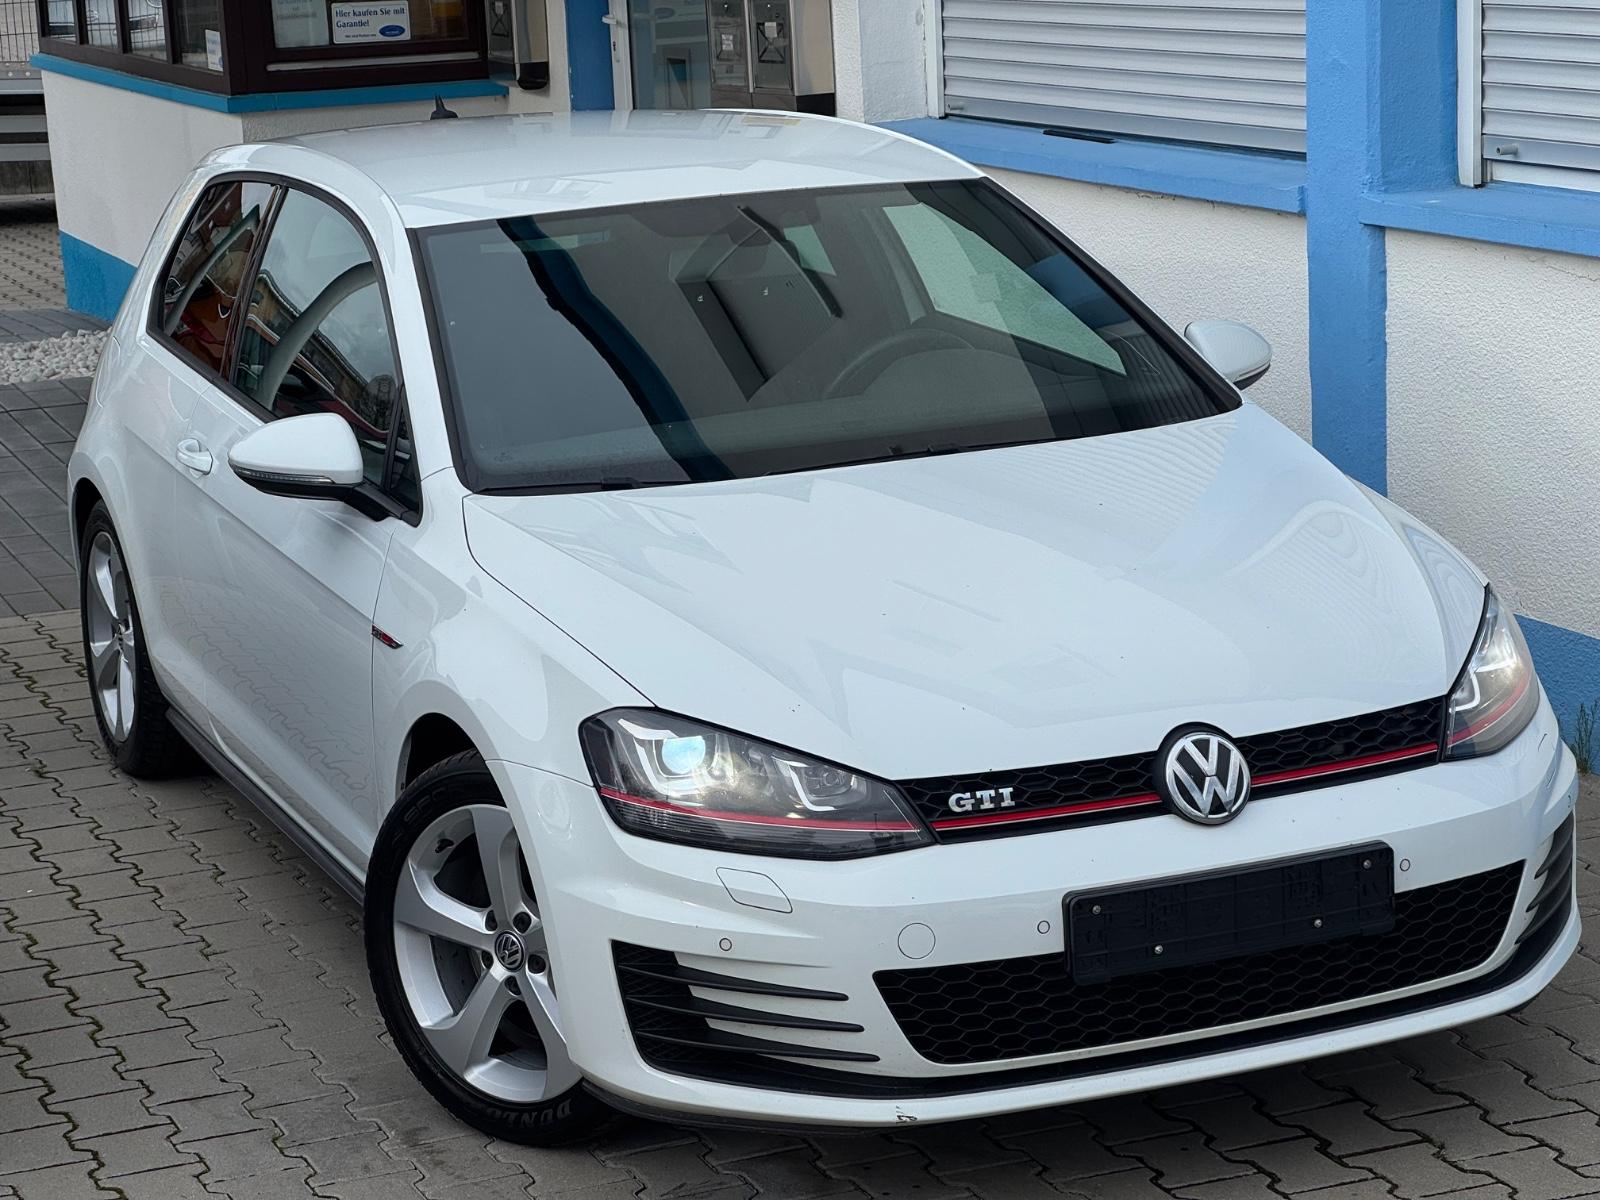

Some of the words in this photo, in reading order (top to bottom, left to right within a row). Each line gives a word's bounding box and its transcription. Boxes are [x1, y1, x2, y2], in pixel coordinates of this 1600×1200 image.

[335, 9, 350, 18] Hier
[352, 8, 378, 17] kaufen
[379, 7, 392, 15] Sie
[393, 7, 405, 15] mit
[948, 786, 1016, 813] GTI
